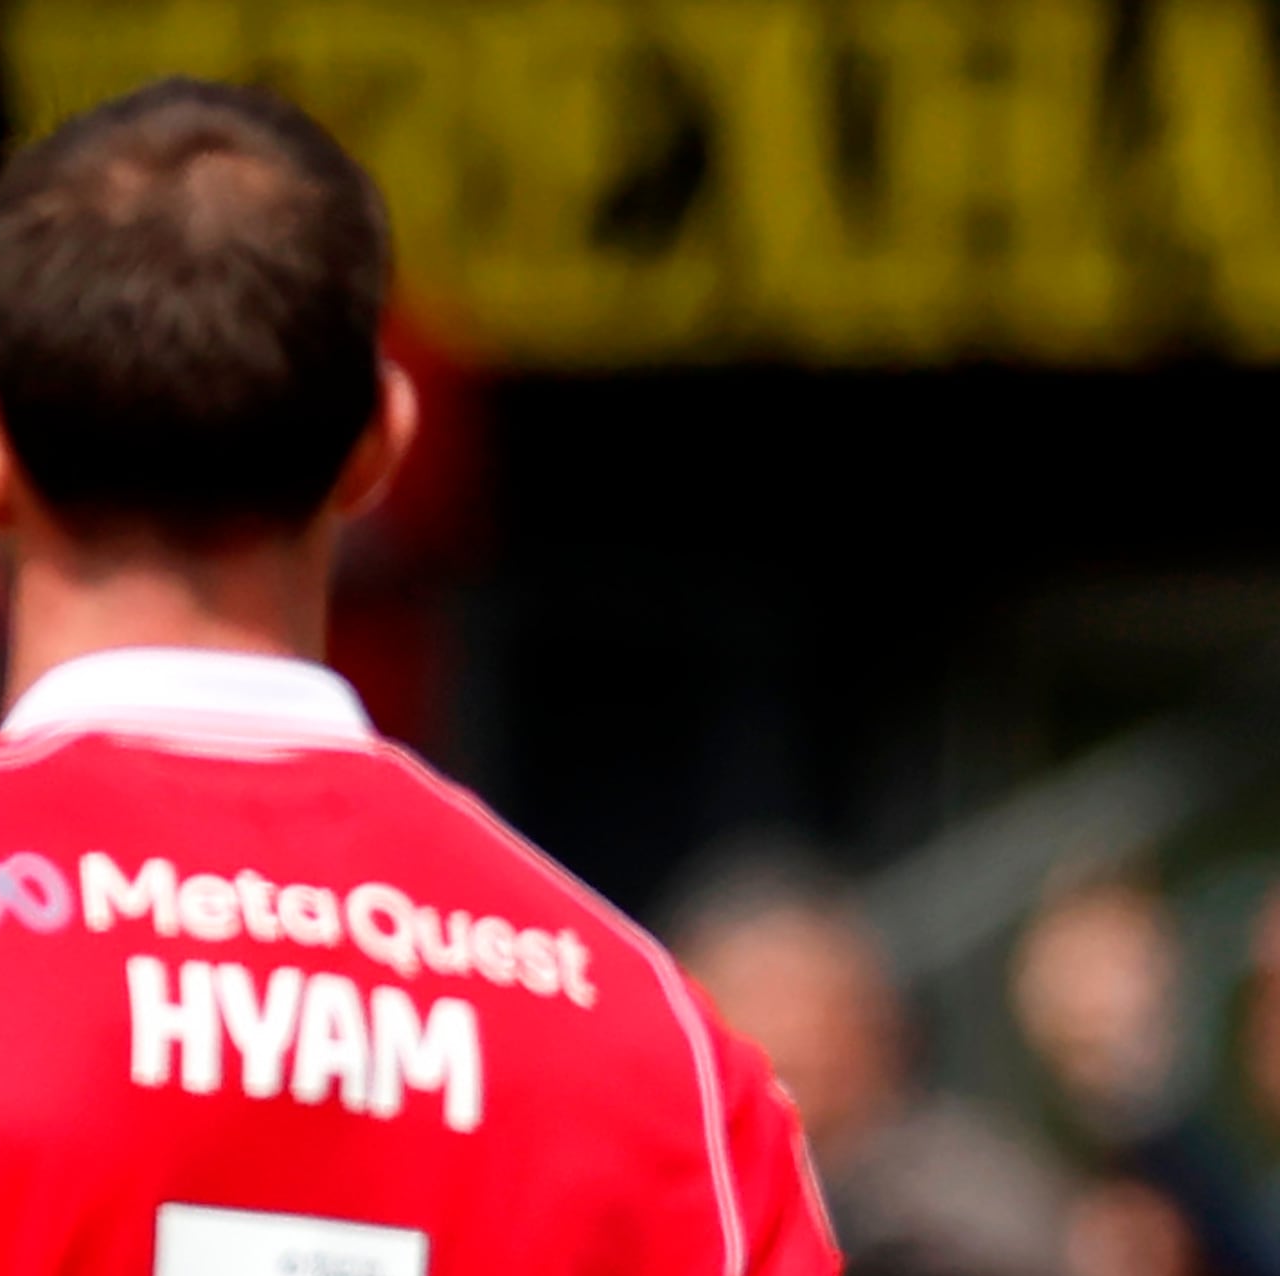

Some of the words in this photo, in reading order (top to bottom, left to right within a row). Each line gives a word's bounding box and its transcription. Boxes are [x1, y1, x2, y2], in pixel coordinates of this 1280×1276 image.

[79, 850, 341, 948] Meta
[345, 881, 596, 1009] Quest
[126, 954, 484, 1133] HYAM
